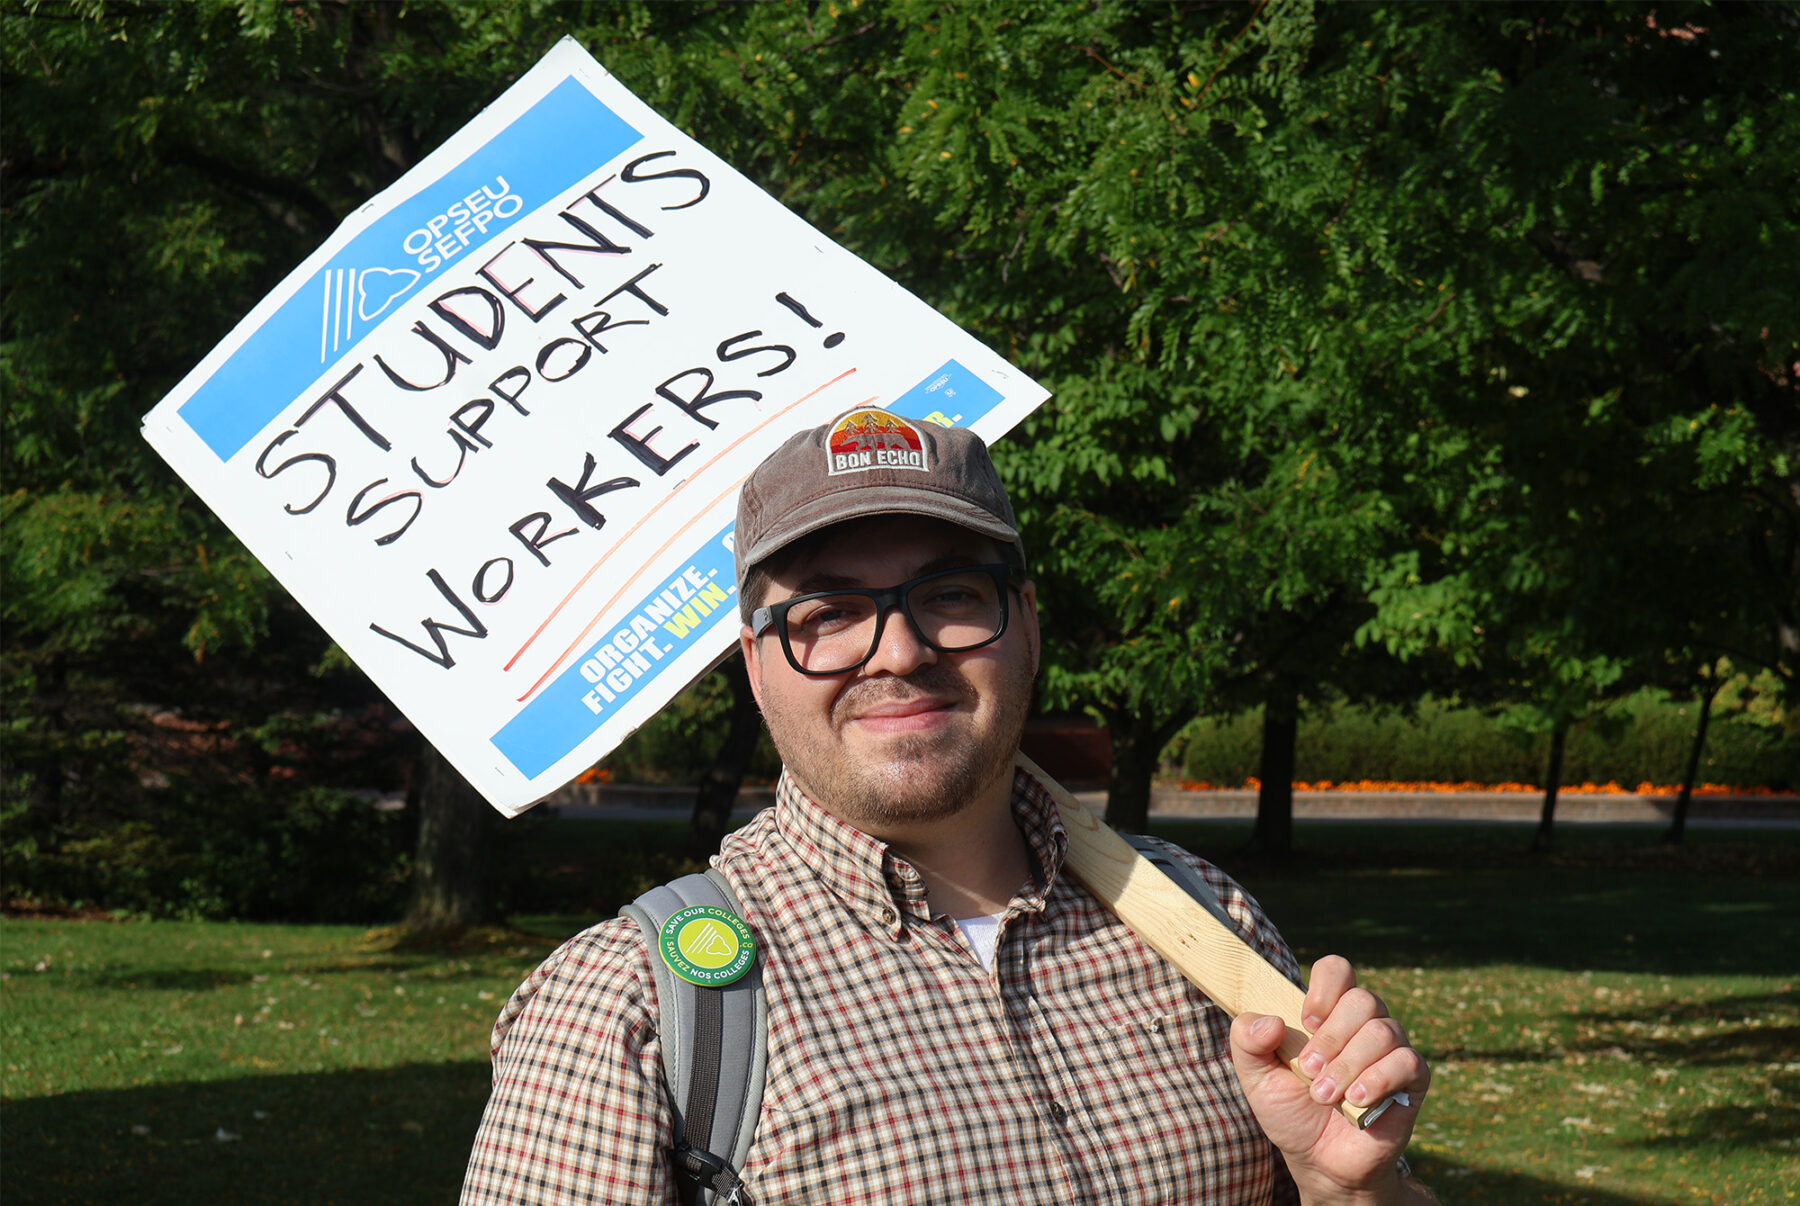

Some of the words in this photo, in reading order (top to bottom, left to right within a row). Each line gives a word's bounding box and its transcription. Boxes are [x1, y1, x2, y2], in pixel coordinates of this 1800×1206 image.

[403, 175, 510, 255] OPSEU
[417, 194, 523, 274] SEFPO
[255, 150, 711, 516] STUDENTS
[346, 263, 669, 546] SUPPORT
[836, 451, 871, 470] BON
[877, 450, 920, 466] ECHO
[579, 565, 718, 684] ORGANIZE.
[581, 636, 674, 715] FIGHT.
[662, 581, 737, 639] WIN.
[666, 915, 684, 935] SAVE
[683, 908, 705, 918] OUR
[708, 908, 750, 939] COLLEGES
[666, 942, 691, 972] SAUVEZ
[690, 969, 711, 979] NOS
[713, 950, 750, 979] COLLEGES
